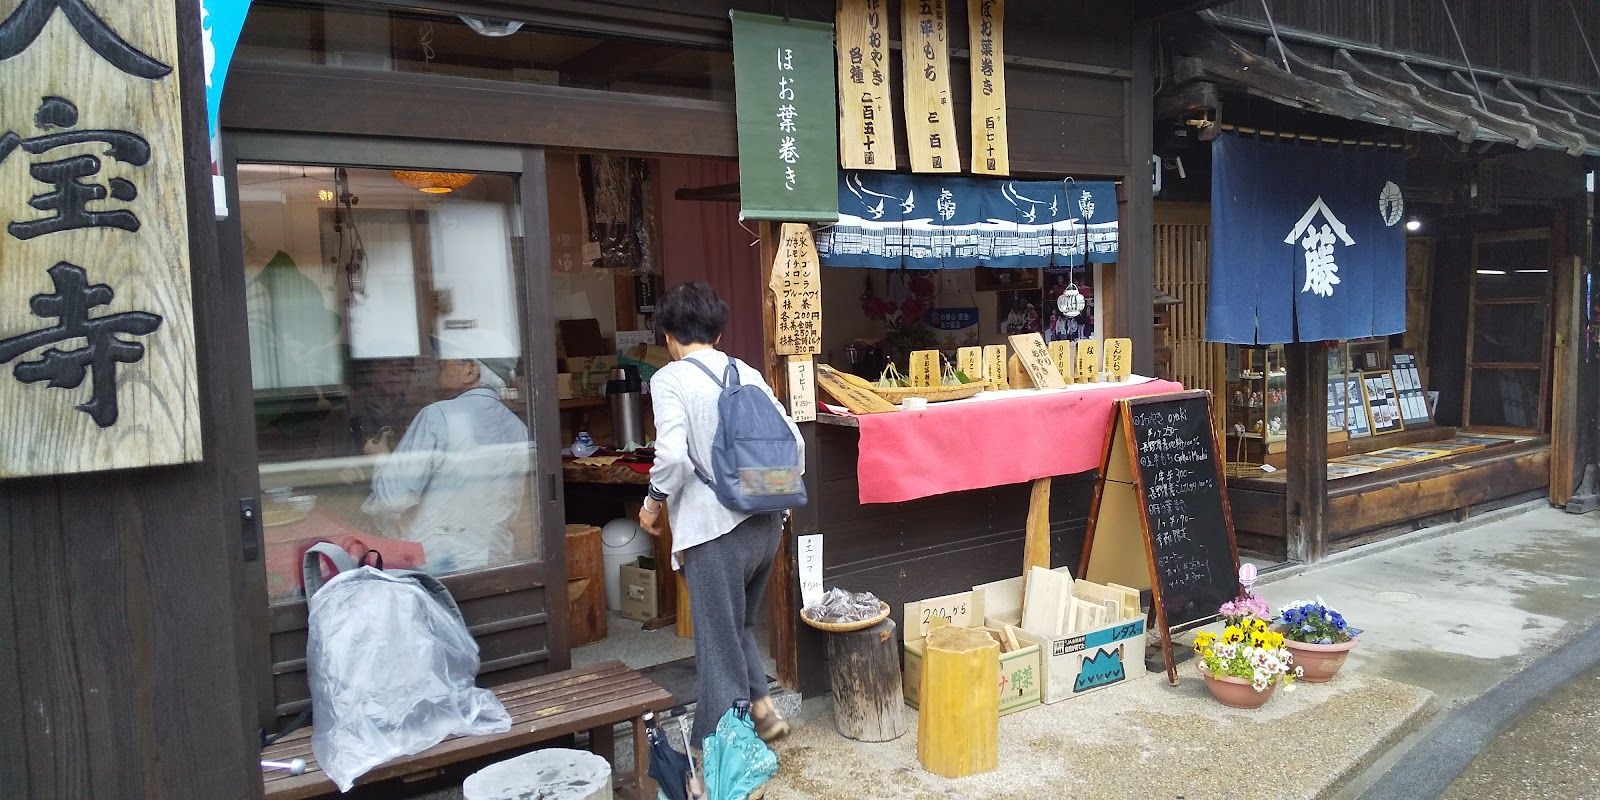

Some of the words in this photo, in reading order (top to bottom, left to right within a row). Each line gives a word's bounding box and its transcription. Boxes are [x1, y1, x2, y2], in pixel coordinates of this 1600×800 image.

[849, 47, 865, 84] 各種
[776, 47, 801, 191] ほお葉巻き
[785, 259, 811, 270] イチゴ
[1300, 223, 1341, 298] 藤
[784, 270, 811, 279] メロン
[784, 280, 810, 290] コーラ
[1112, 624, 1136, 640] レタス
